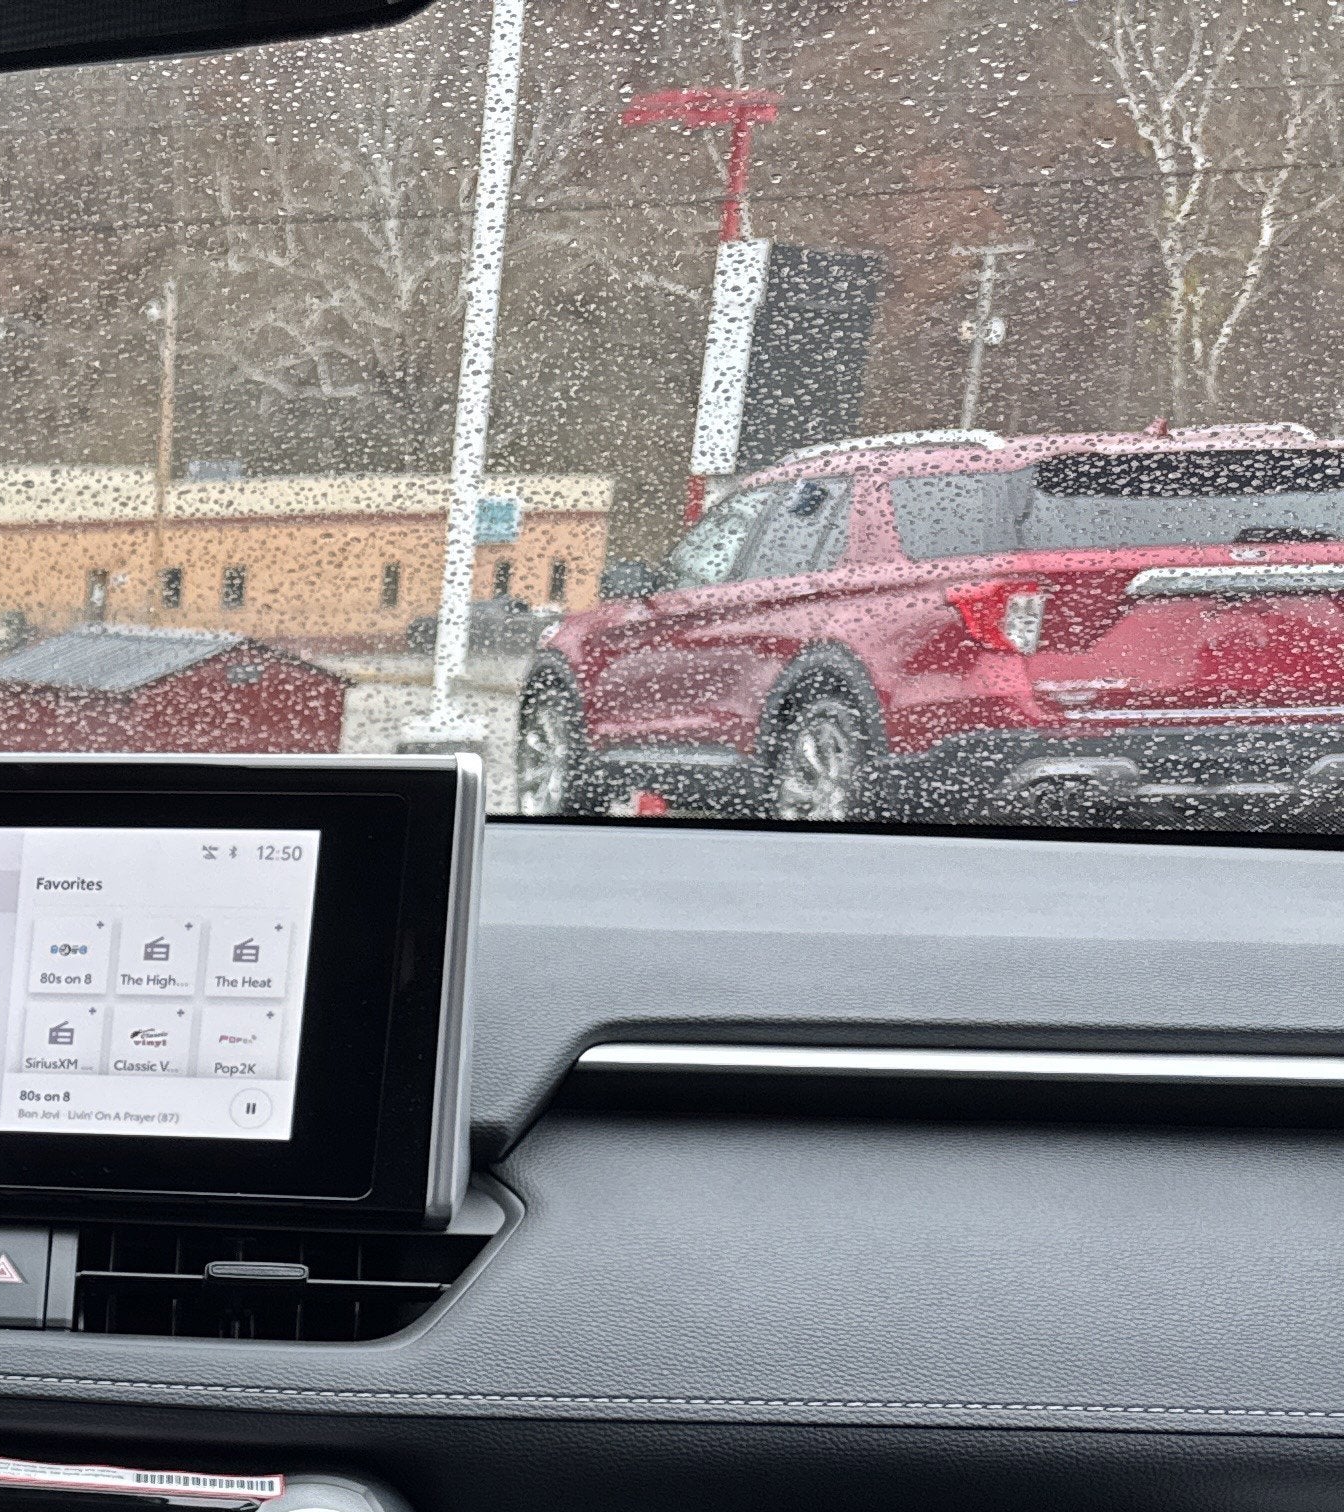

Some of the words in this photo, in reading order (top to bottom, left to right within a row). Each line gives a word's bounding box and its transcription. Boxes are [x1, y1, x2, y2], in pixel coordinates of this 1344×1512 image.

[256, 845, 303, 861] 12:50
[35, 876, 103, 891] Favorites
[40, 973, 62, 985] 80s
[65, 976, 81, 985] on
[84, 973, 93, 985] 8
[120, 974, 143, 986] The
[215, 976, 238, 988] The
[241, 977, 272, 989] Heat
[25, 1057, 79, 1071] SiriusXM
[113, 1059, 158, 1073] Classic
[214, 1062, 256, 1077] Pop2K
[19, 1090, 41, 1102] 80s
[44, 1093, 60, 1102] on
[62, 1091, 71, 1102] 8
[17, 1108, 39, 1119] Bon
[40, 1109, 60, 1120] Jovi
[95, 1111, 112, 1121] On
[113, 1112, 122, 1121] A
[123, 1112, 155, 1124] Prayer
